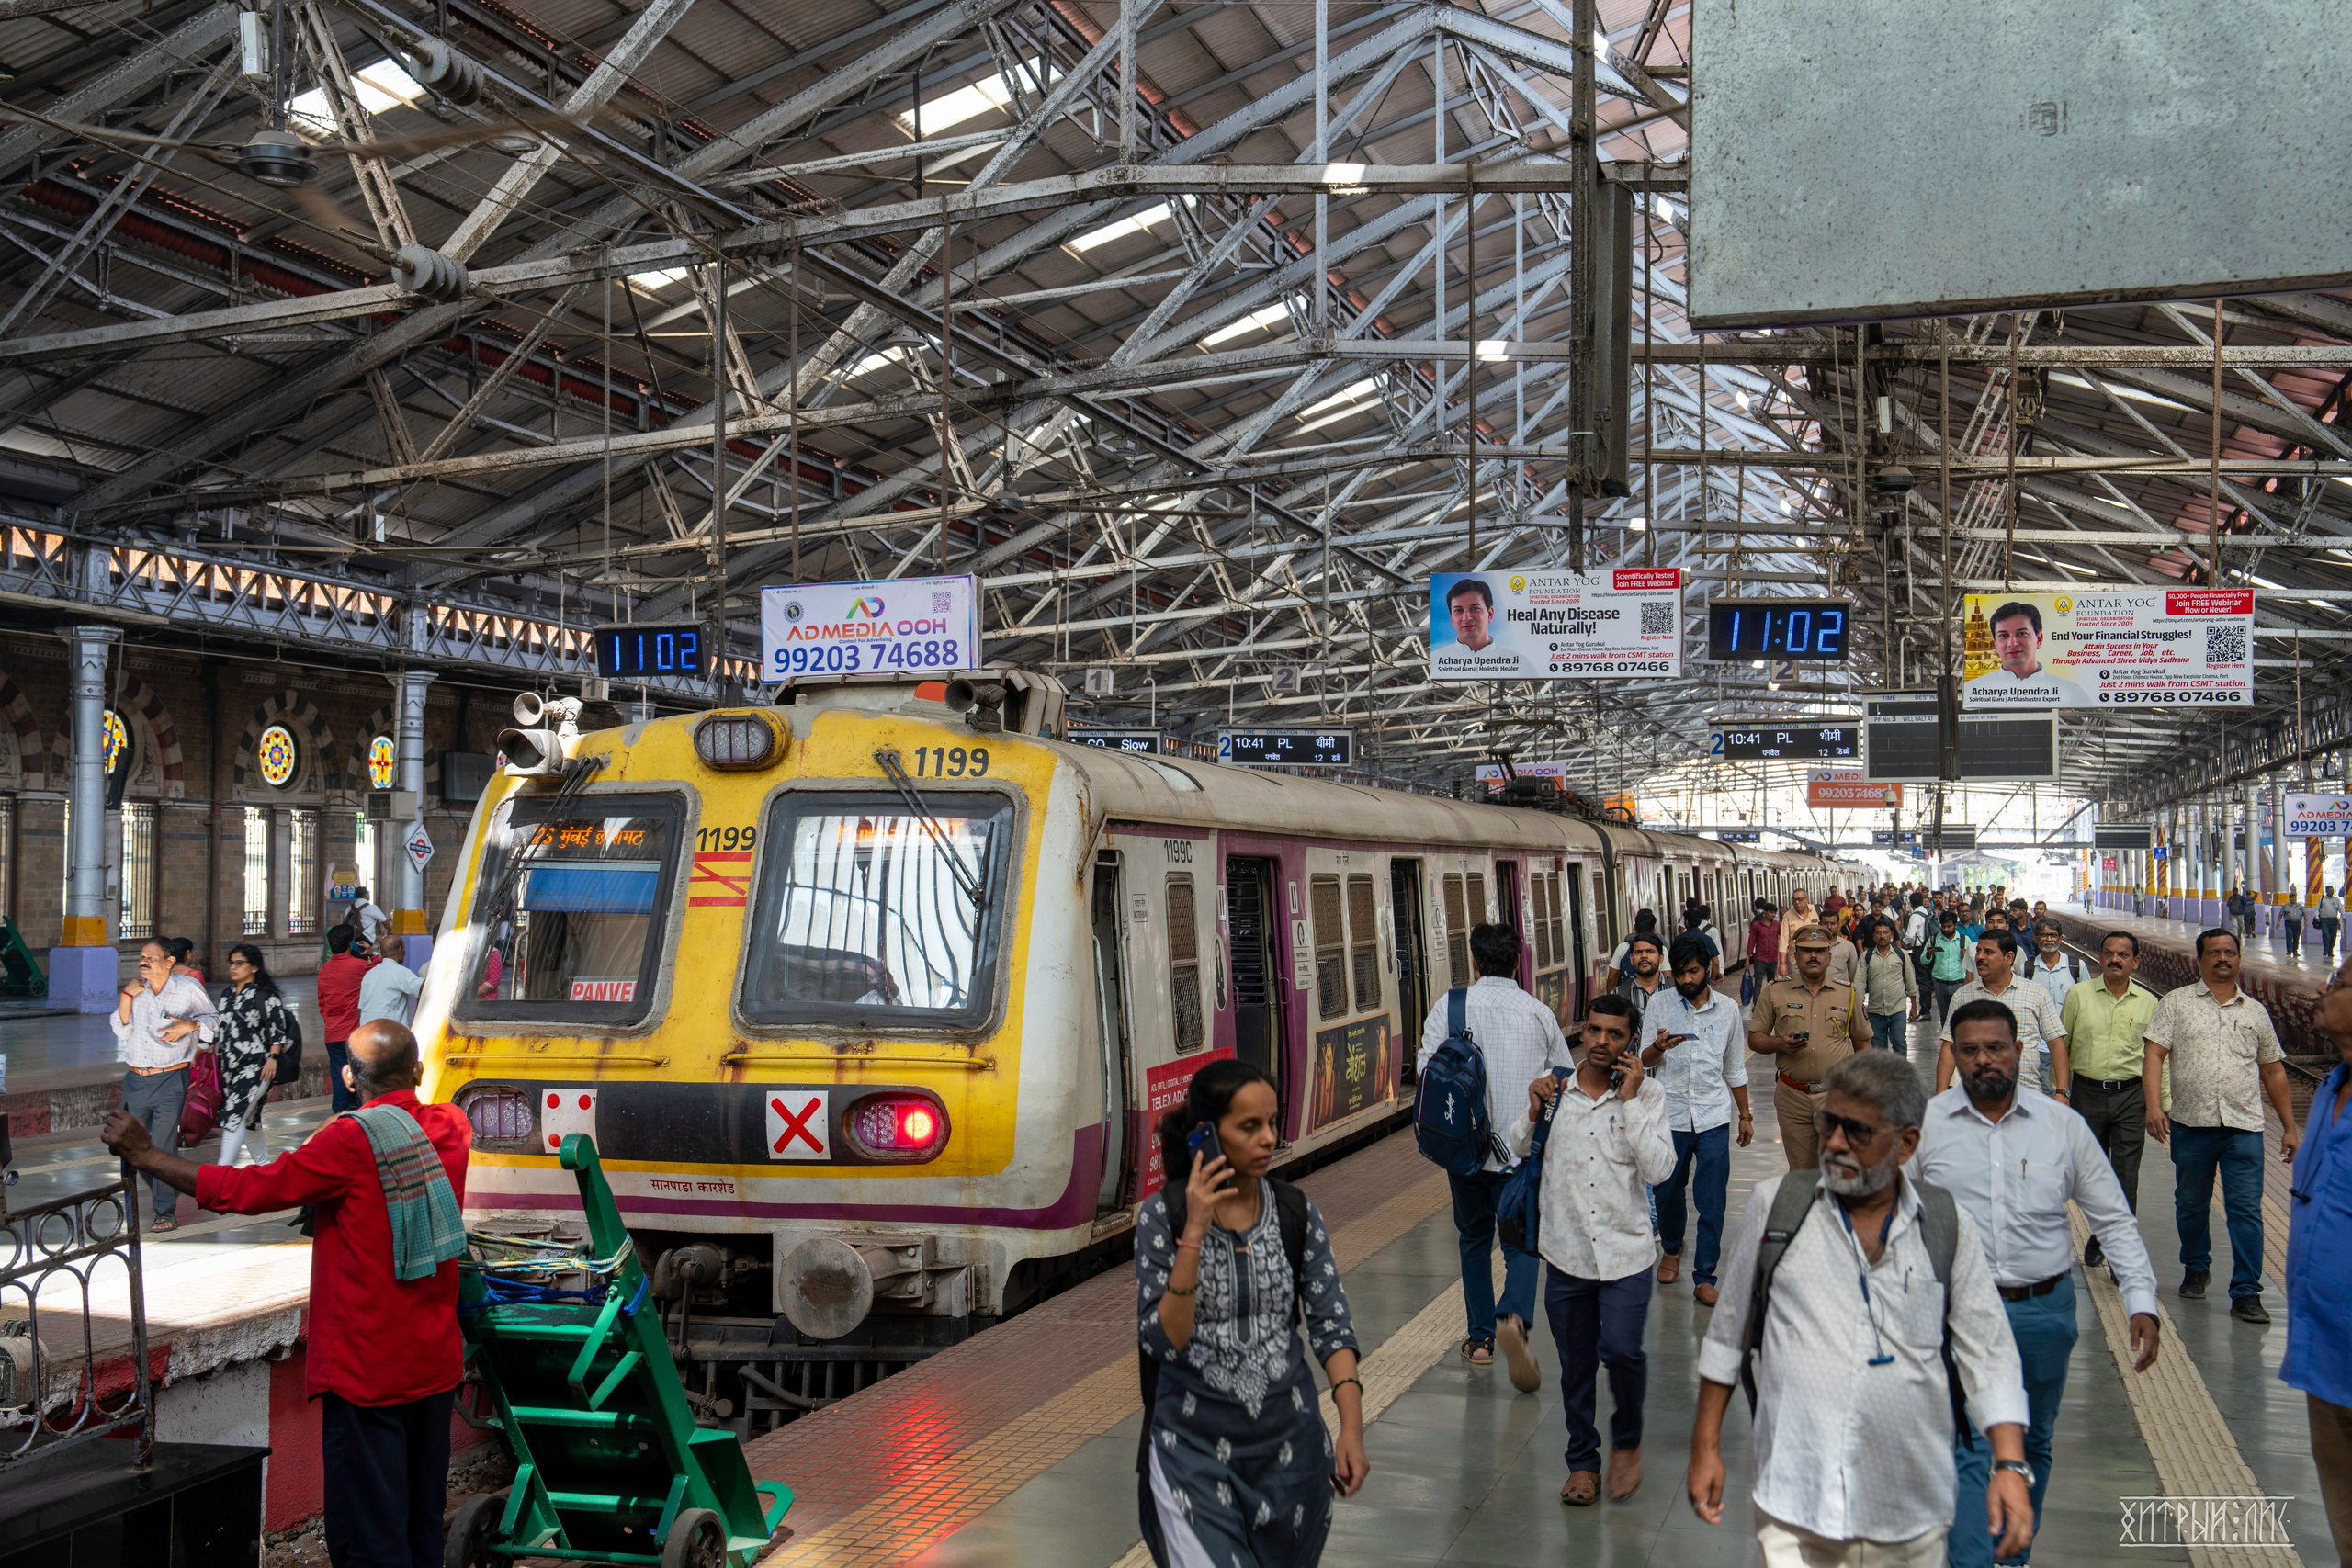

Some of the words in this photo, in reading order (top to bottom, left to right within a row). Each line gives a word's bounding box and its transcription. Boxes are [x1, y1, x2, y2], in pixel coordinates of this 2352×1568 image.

[1530, 577, 1569, 587] ANTAR
[1574, 576, 1600, 586] YOG
[2076, 597, 2122, 608] ANTAR
[2126, 597, 2155, 608] YOG
[2176, 600, 2190, 608] Join
[1507, 608, 1536, 621] Heal
[1539, 608, 1566, 623] Any
[1567, 607, 1620, 621] Disease
[786, 625, 820, 641] AD
[821, 621, 895, 640] MEDIA
[897, 618, 946, 637] OOH
[1531, 621, 1597, 637] Naturally!
[1731, 611, 1843, 652] 11:02
[2051, 632, 2069, 641] End
[2071, 632, 2095, 641] Your
[2095, 630, 2140, 640] Financial
[2141, 630, 2192, 641] Struggles!
[775, 645, 861, 673] 99203
[870, 639, 959, 670] 74688
[2140, 649, 2155, 658] Job,
[1439, 656, 1472, 666] Acharya
[1475, 656, 1508, 665] Upendra
[1510, 656, 1520, 665] Ji
[1562, 663, 1614, 672] 89768
[1617, 661, 1670, 671] 07466
[1775, 660, 1794, 680] 2
[1090, 671, 1102, 691] 1
[1277, 668, 1294, 689] 2
[2168, 681, 2188, 689] from
[1972, 687, 2008, 697] Acharya
[2010, 687, 2050, 696] Upendra
[2052, 687, 2058, 695] Ji
[2114, 692, 2176, 702] 89768
[2179, 691, 2241, 702] 07466
[1316, 735, 1334, 749] धीमी
[1728, 733, 1760, 744] 10:41
[1777, 733, 1793, 744] PL
[1820, 729, 1841, 742] धीमी
[1121, 739, 1148, 751] Slow
[1219, 737, 1231, 757] 2
[1235, 738, 1264, 748] 10:41
[1278, 739, 1293, 748] PL
[1711, 733, 1724, 755] 2
[915, 747, 989, 777] 1199
[1315, 754, 1323, 762] 12
[1819, 788, 1854, 798] 99203
[2290, 821, 2336, 832] 99203
[559, 826, 593, 849] मुंबई
[696, 827, 756, 851] 1199
[1164, 840, 1193, 863] 1199C
[573, 982, 636, 1001] PANVE
[1152, 1093, 1172, 1111] TELEX
[650, 1179, 693, 1192] सानपाडा
[696, 1179, 735, 1194] कारशेड
